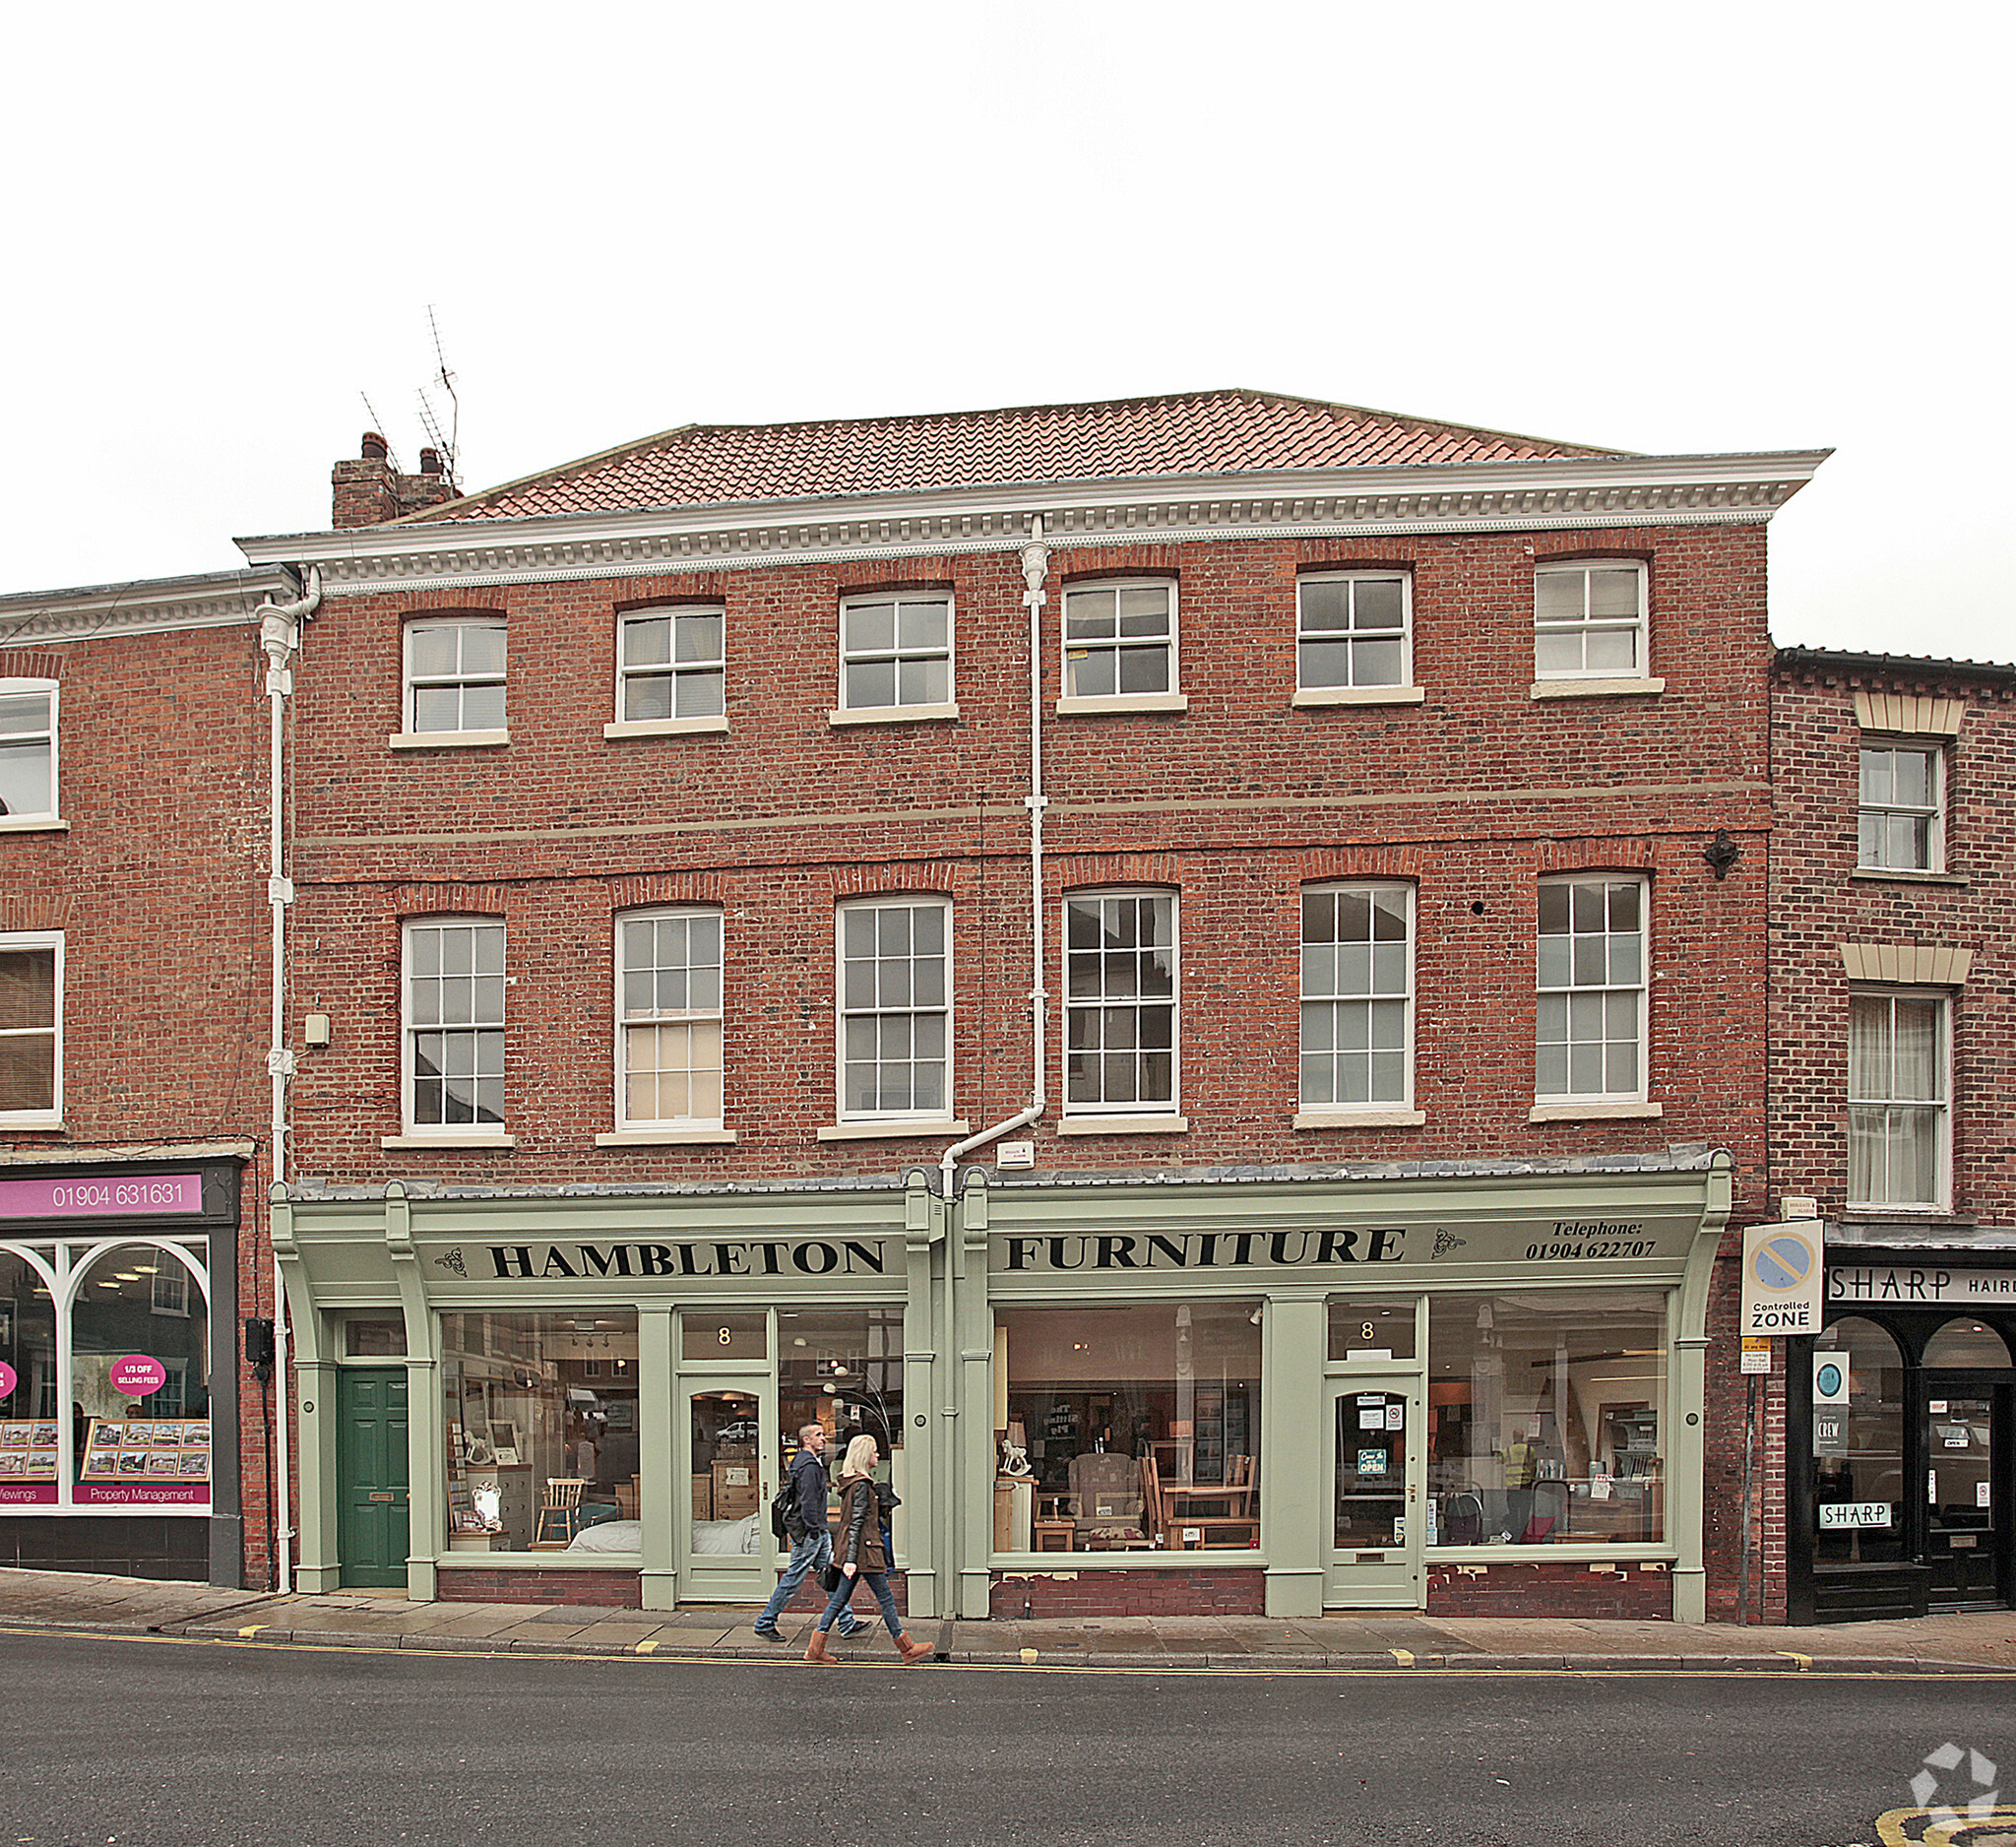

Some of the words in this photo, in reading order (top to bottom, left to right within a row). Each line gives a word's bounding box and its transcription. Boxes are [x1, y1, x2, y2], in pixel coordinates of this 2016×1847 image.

[52, 1185, 110, 1207] 01904
[115, 1183, 182, 1205] 631631
[1552, 1221, 1643, 1239] Telephone:
[1003, 1228, 1408, 1271] FURNITURE
[1526, 1242, 1583, 1259] 01904
[1586, 1241, 1657, 1258] 622707
[485, 1240, 887, 1279] HAMBLETON
[1831, 1268, 1951, 1301] SHARP
[1753, 1301, 1809, 1311] Controlled
[1751, 1311, 1810, 1328] ZONE
[718, 1326, 731, 1345] 8
[1360, 1321, 1374, 1340] 8
[125, 1365, 136, 1373] 1/3
[137, 1365, 153, 1373] OFF
[1818, 1422, 1840, 1437] CREW
[1360, 1463, 1384, 1472] OPEN
[91, 1488, 130, 1502] Property
[131, 1488, 194, 1502] Management
[1825, 1504, 1887, 1526] SHARP
